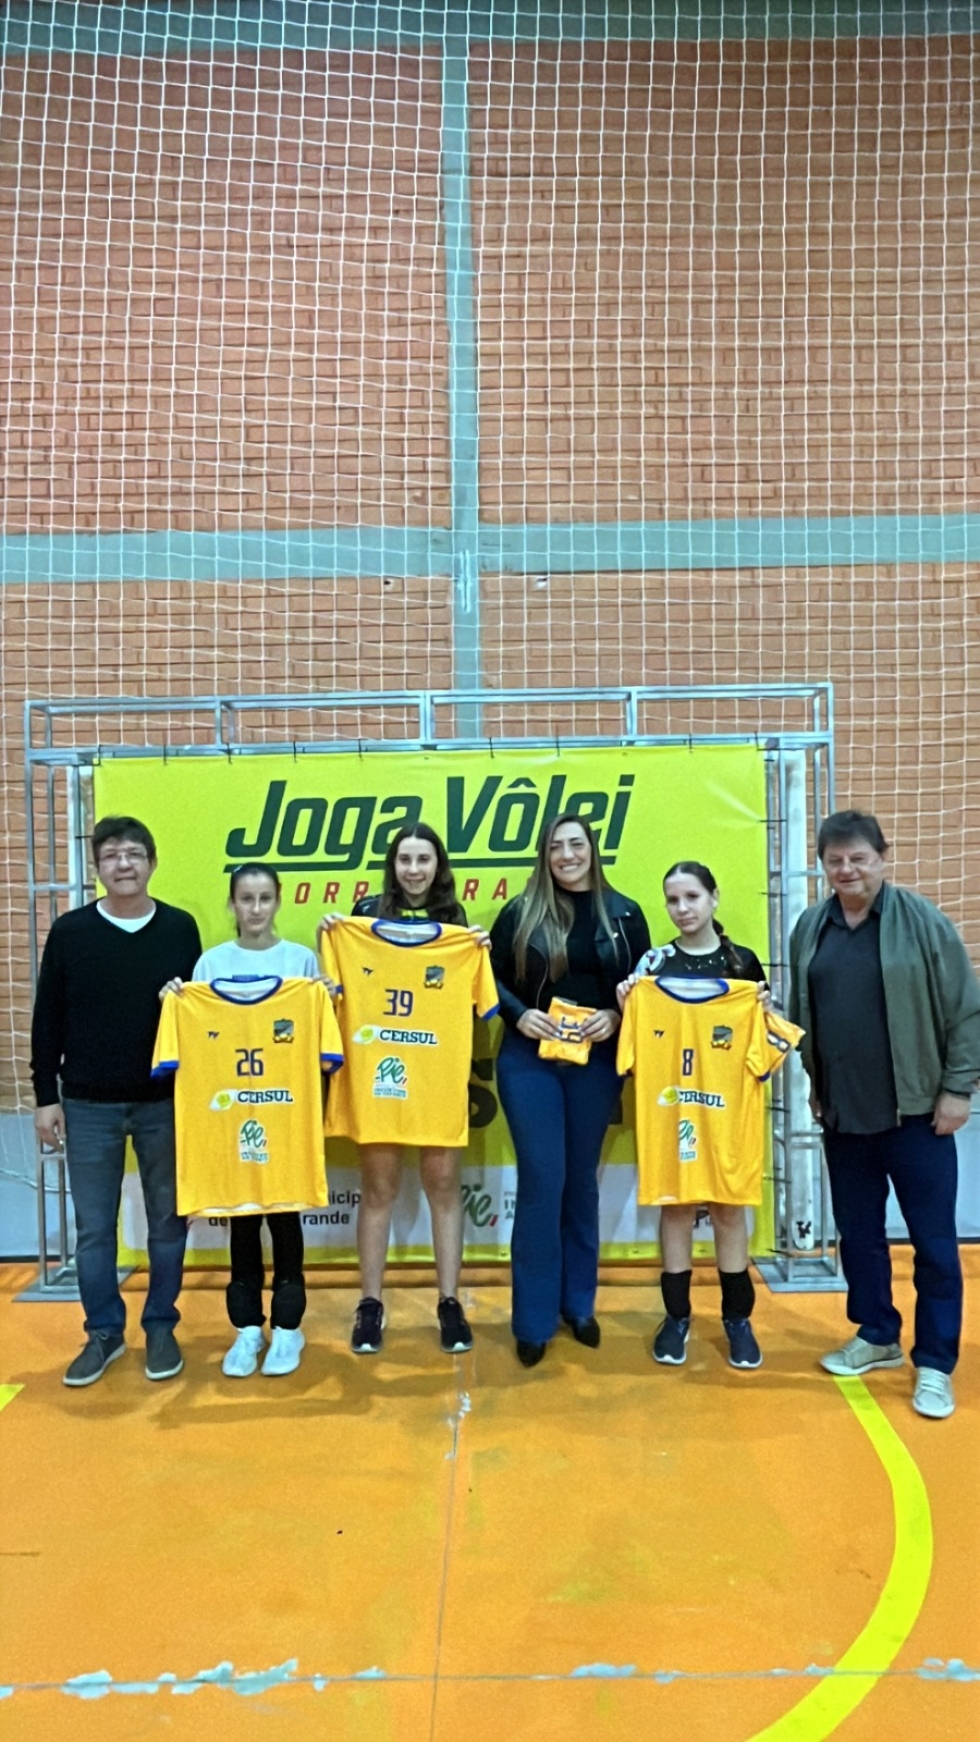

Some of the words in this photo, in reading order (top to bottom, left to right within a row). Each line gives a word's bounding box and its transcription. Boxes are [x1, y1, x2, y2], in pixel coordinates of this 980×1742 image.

[225, 780, 423, 871] Joga
[447, 774, 635, 853] Vôlei
[280, 880, 369, 904] ORR
[383, 989, 413, 1016] 39
[380, 1029, 438, 1045] CERSUL
[235, 1048, 264, 1076] 26
[682, 1048, 694, 1076] 8
[238, 1090, 293, 1104] CERSUL
[303, 1211, 350, 1225] rande
